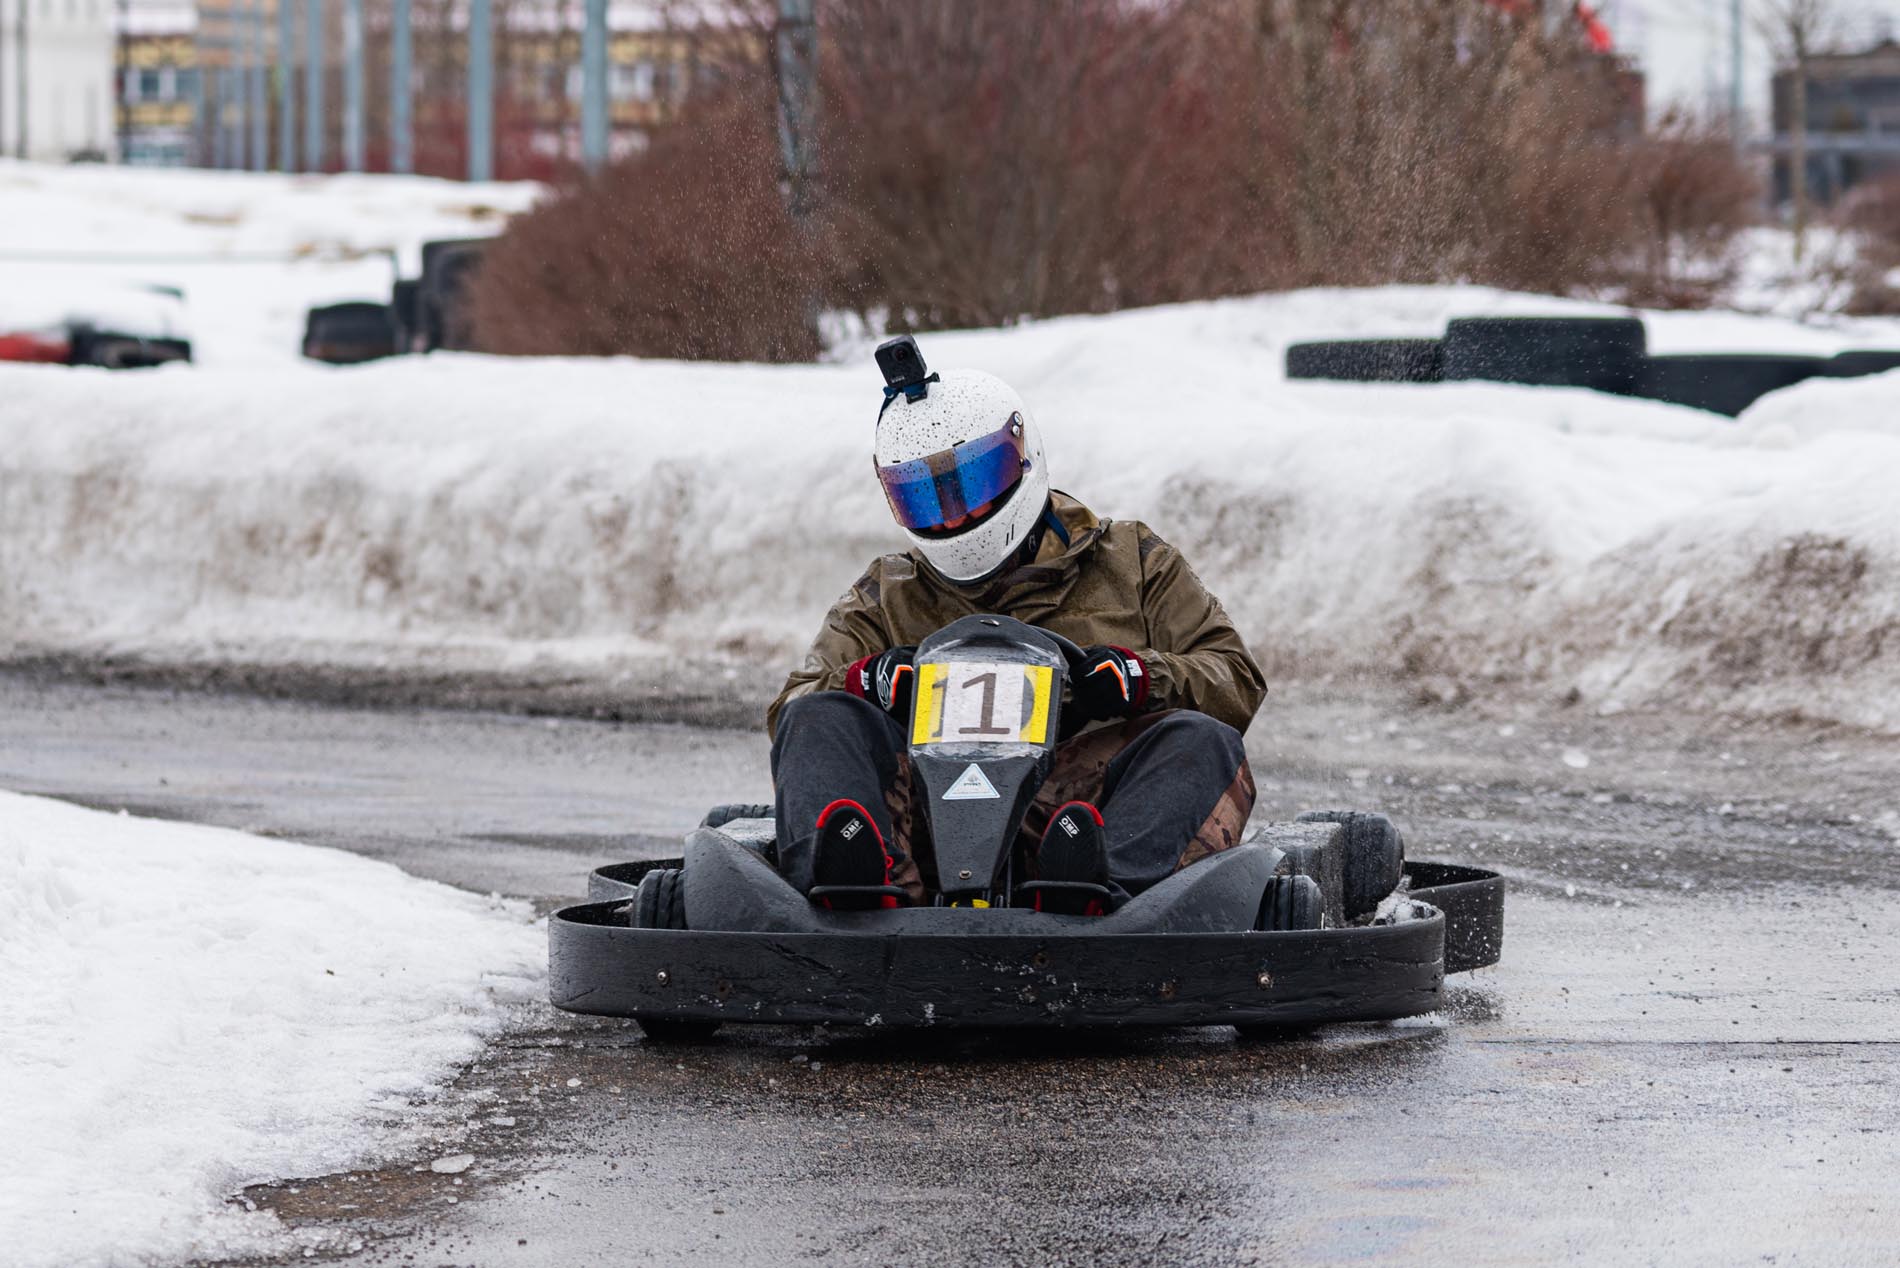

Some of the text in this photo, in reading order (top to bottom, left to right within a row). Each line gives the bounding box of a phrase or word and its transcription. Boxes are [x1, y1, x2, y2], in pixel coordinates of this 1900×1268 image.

[958, 672, 1010, 735] 1
[842, 820, 861, 838] OMP
[1060, 817, 1079, 836] OMP
